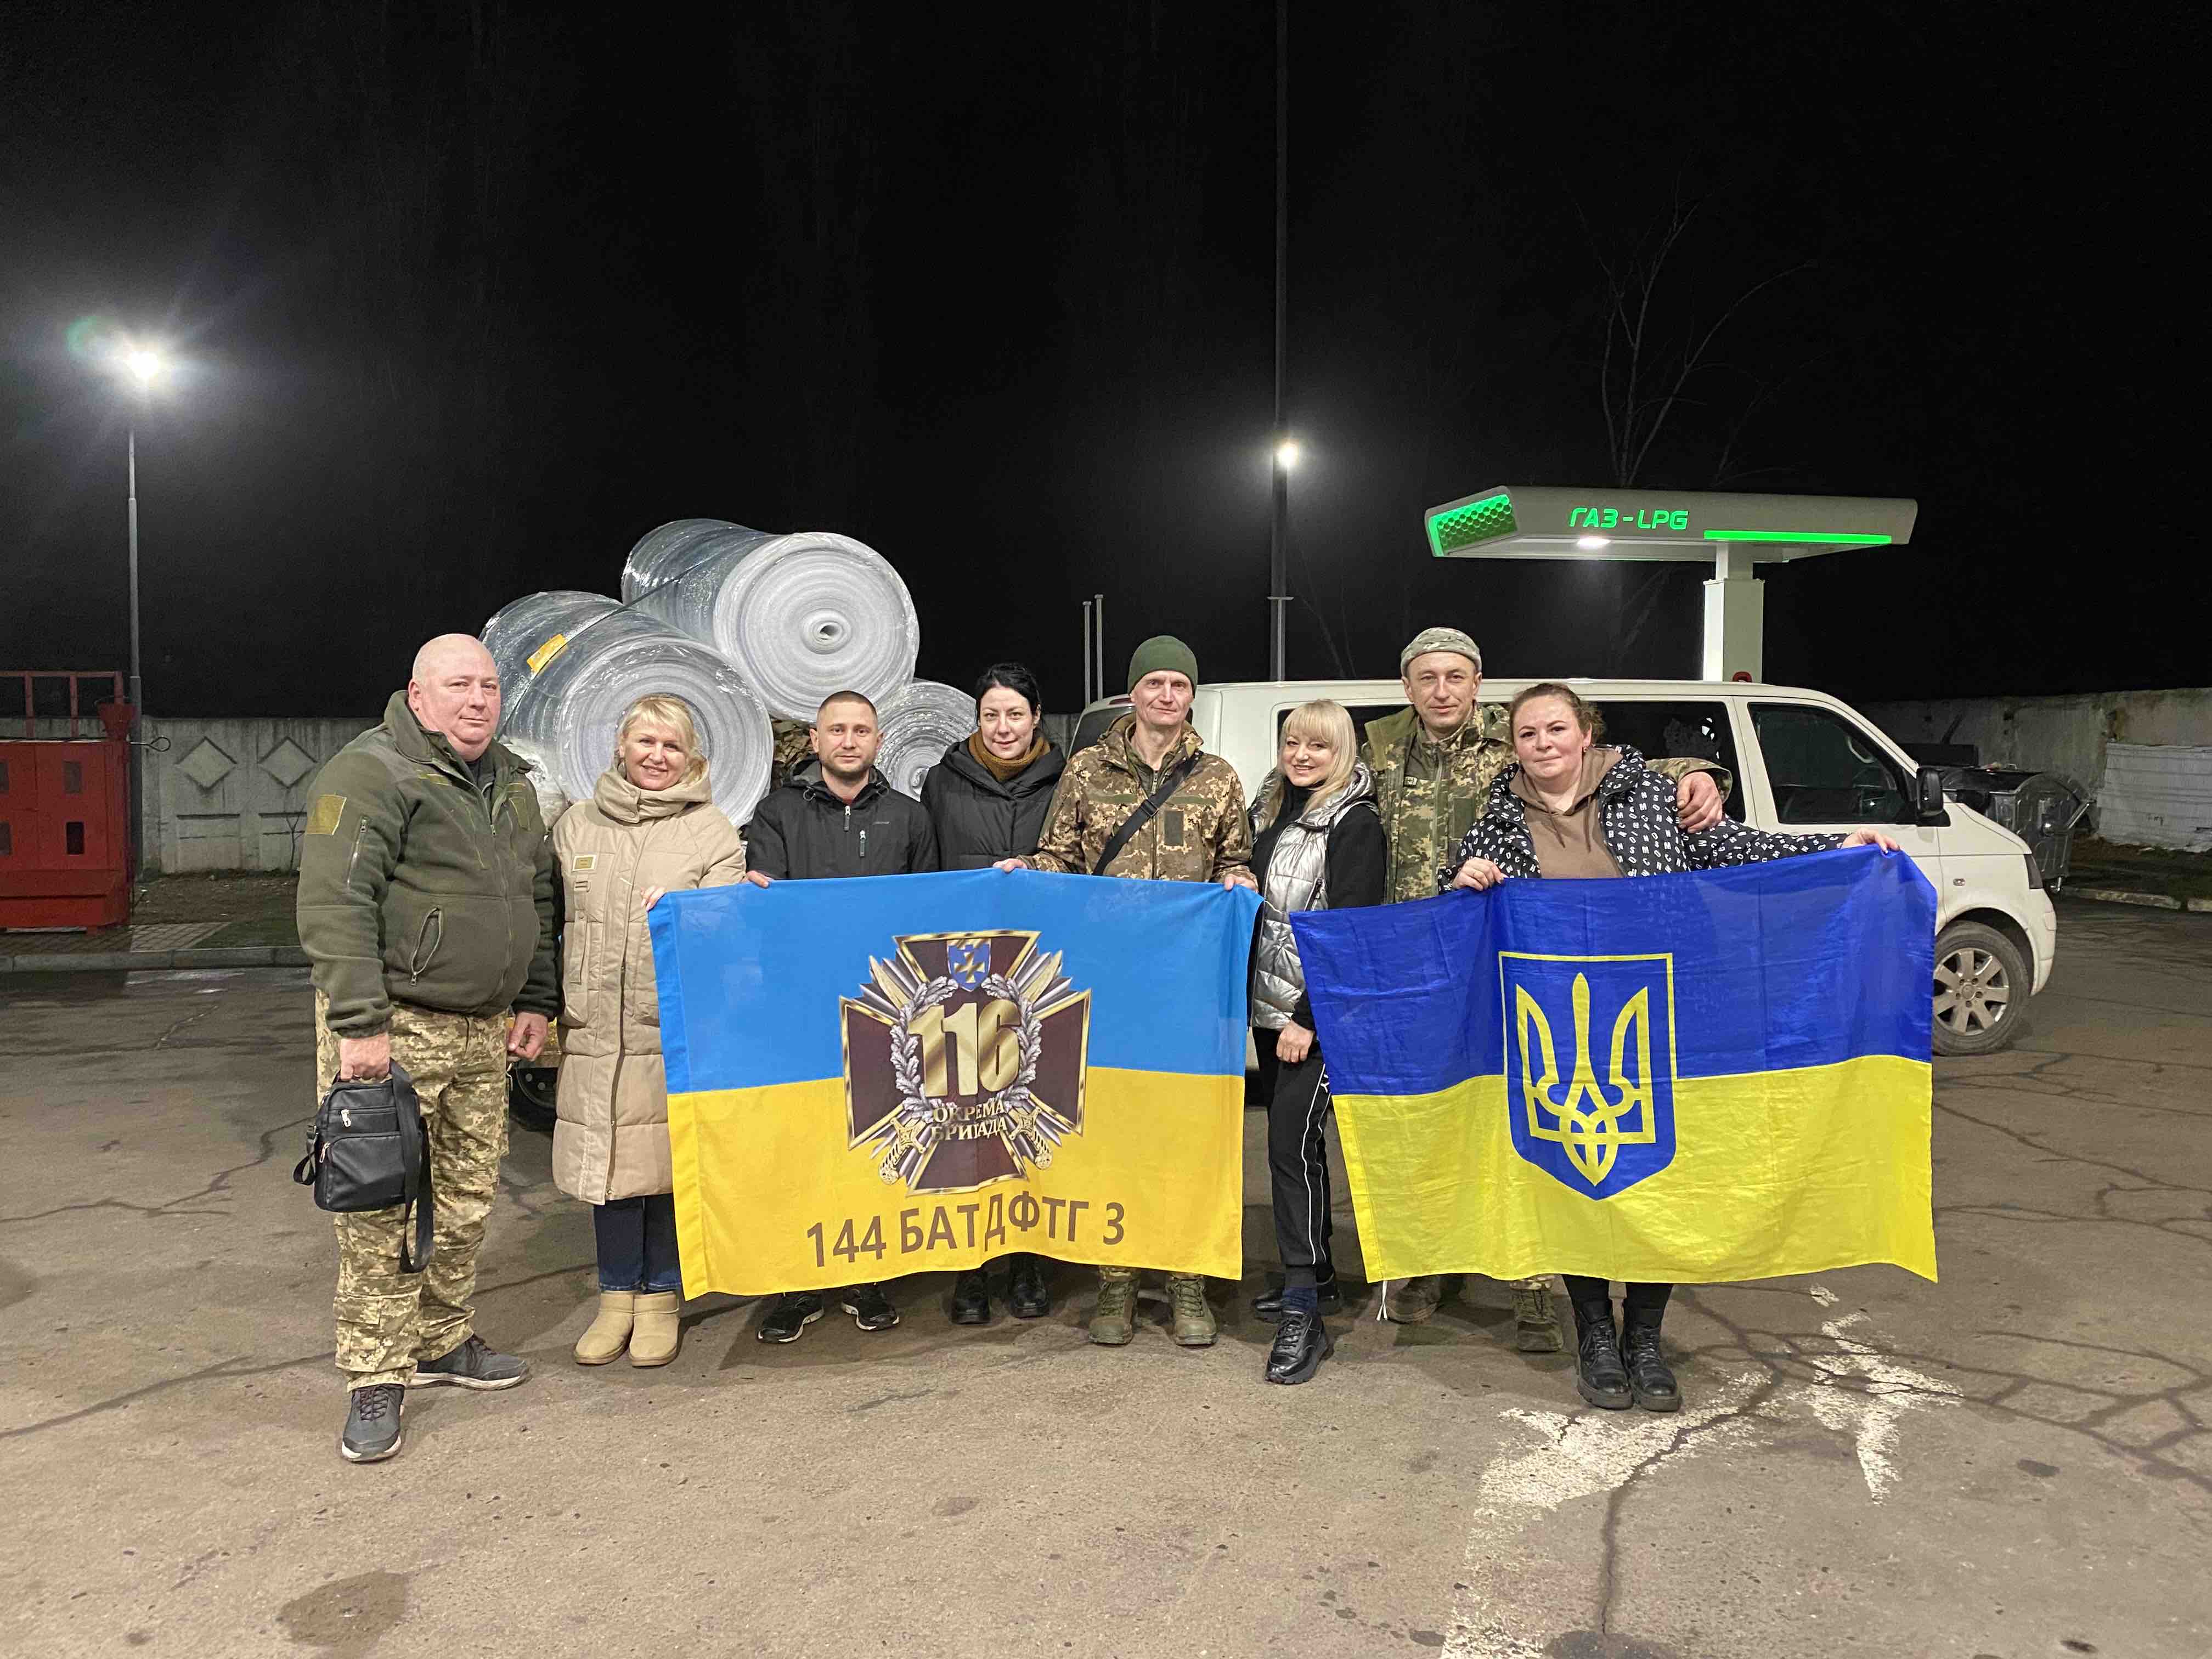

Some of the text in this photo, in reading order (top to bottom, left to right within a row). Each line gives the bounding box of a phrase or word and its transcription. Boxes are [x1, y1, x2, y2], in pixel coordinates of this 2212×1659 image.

[908, 999, 1022, 1097] 116
[933, 1098, 1005, 1122] ОКРЕМА
[807, 1215, 887, 1267] 144
